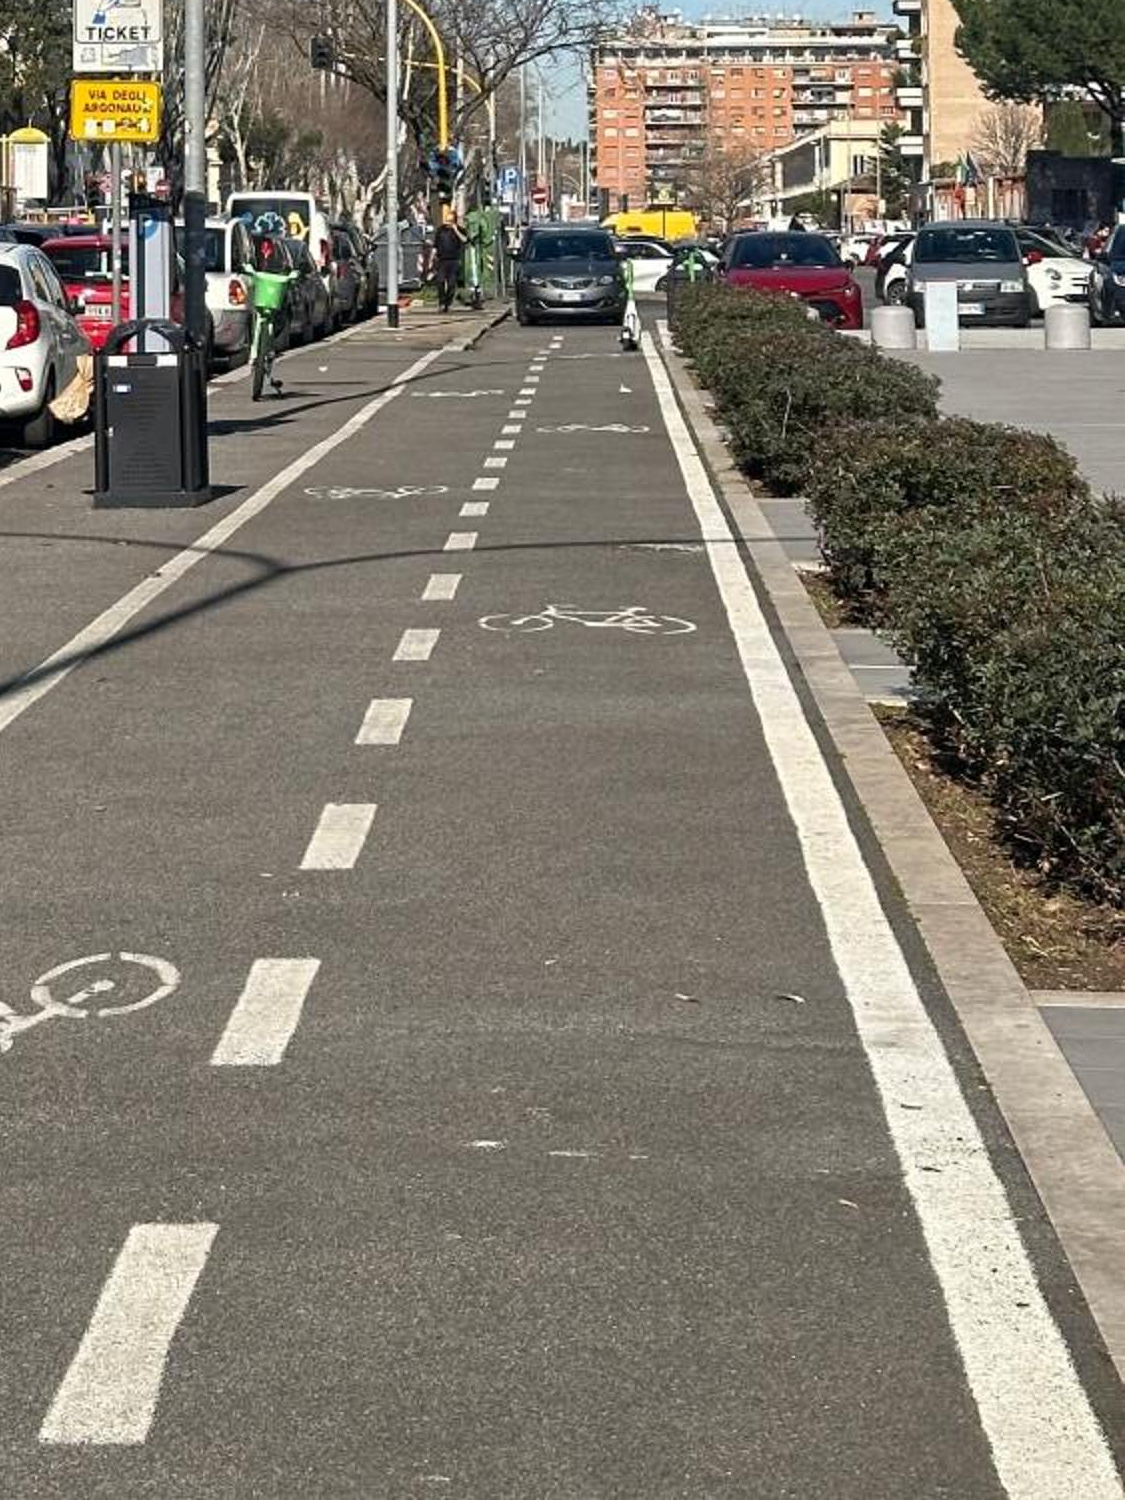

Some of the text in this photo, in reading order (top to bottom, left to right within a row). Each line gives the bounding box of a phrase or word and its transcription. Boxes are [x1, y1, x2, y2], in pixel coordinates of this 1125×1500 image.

[85, 26, 151, 41] TICKET
[88, 89, 146, 101] VIA DEGLI
[504, 168, 517, 183] P
